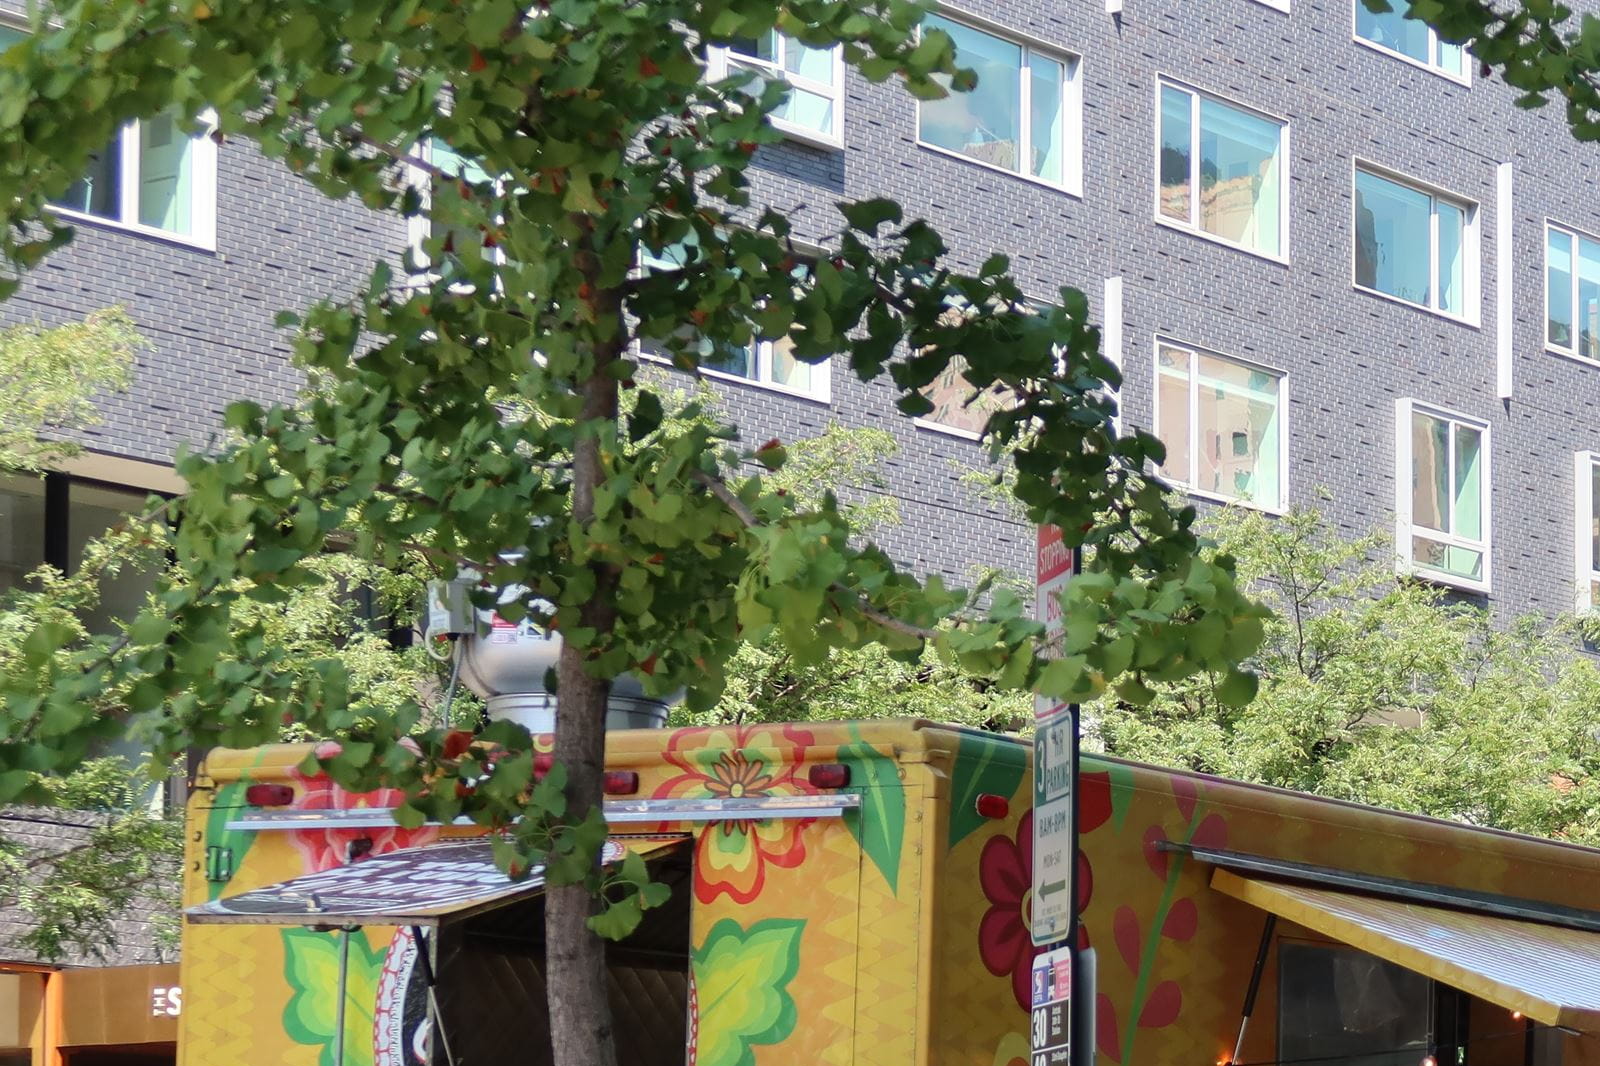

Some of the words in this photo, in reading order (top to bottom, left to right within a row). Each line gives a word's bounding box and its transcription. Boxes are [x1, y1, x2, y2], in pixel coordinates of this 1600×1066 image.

[1037, 740, 1045, 793] 3
[1046, 760, 1070, 794] PARKING
[1033, 1007, 1047, 1049] 30
